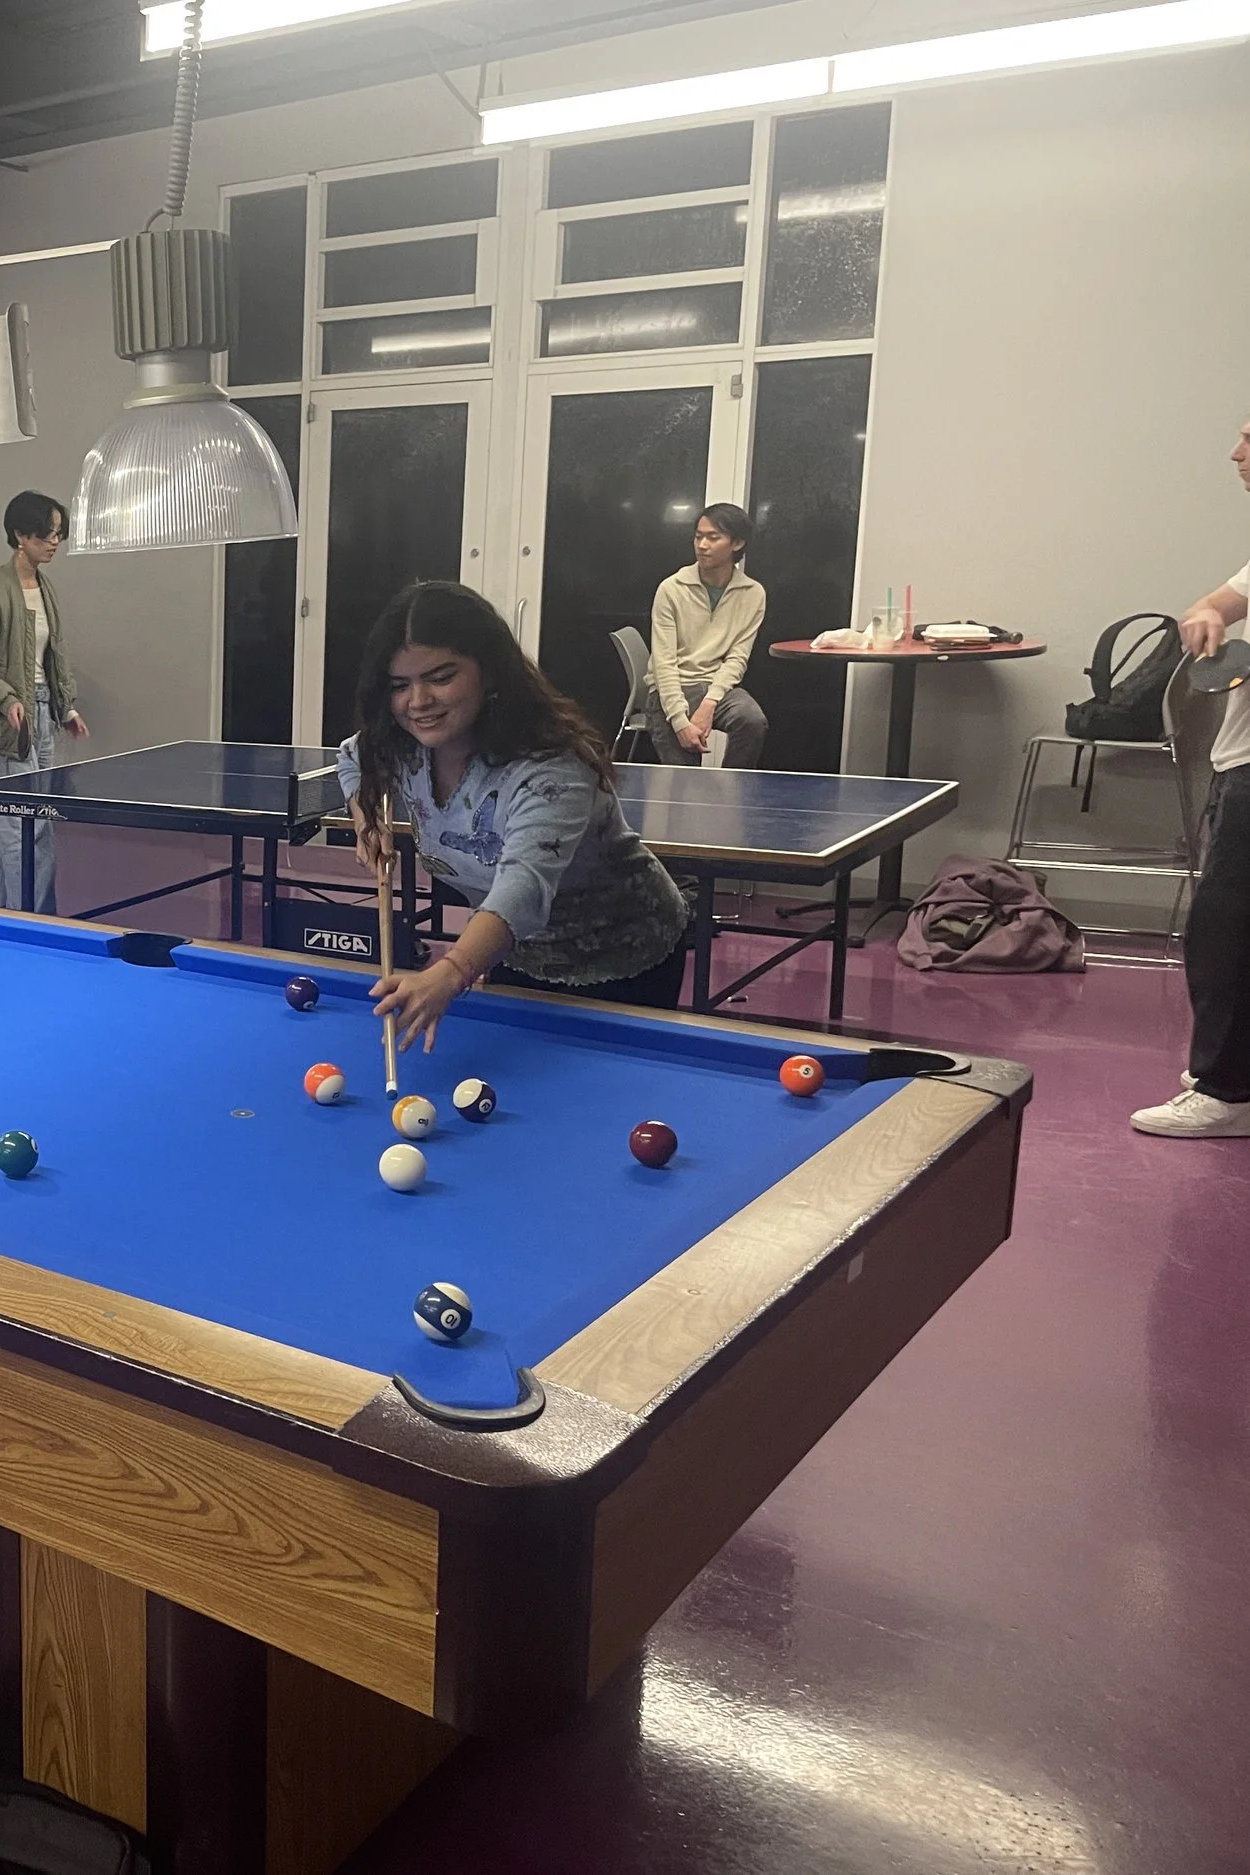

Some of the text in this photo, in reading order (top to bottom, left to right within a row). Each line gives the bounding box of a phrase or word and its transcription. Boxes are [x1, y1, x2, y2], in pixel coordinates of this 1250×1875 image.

[9, 804, 35, 815] Roller
[307, 932, 368, 953] STIGA
[802, 1067, 811, 1075] 5
